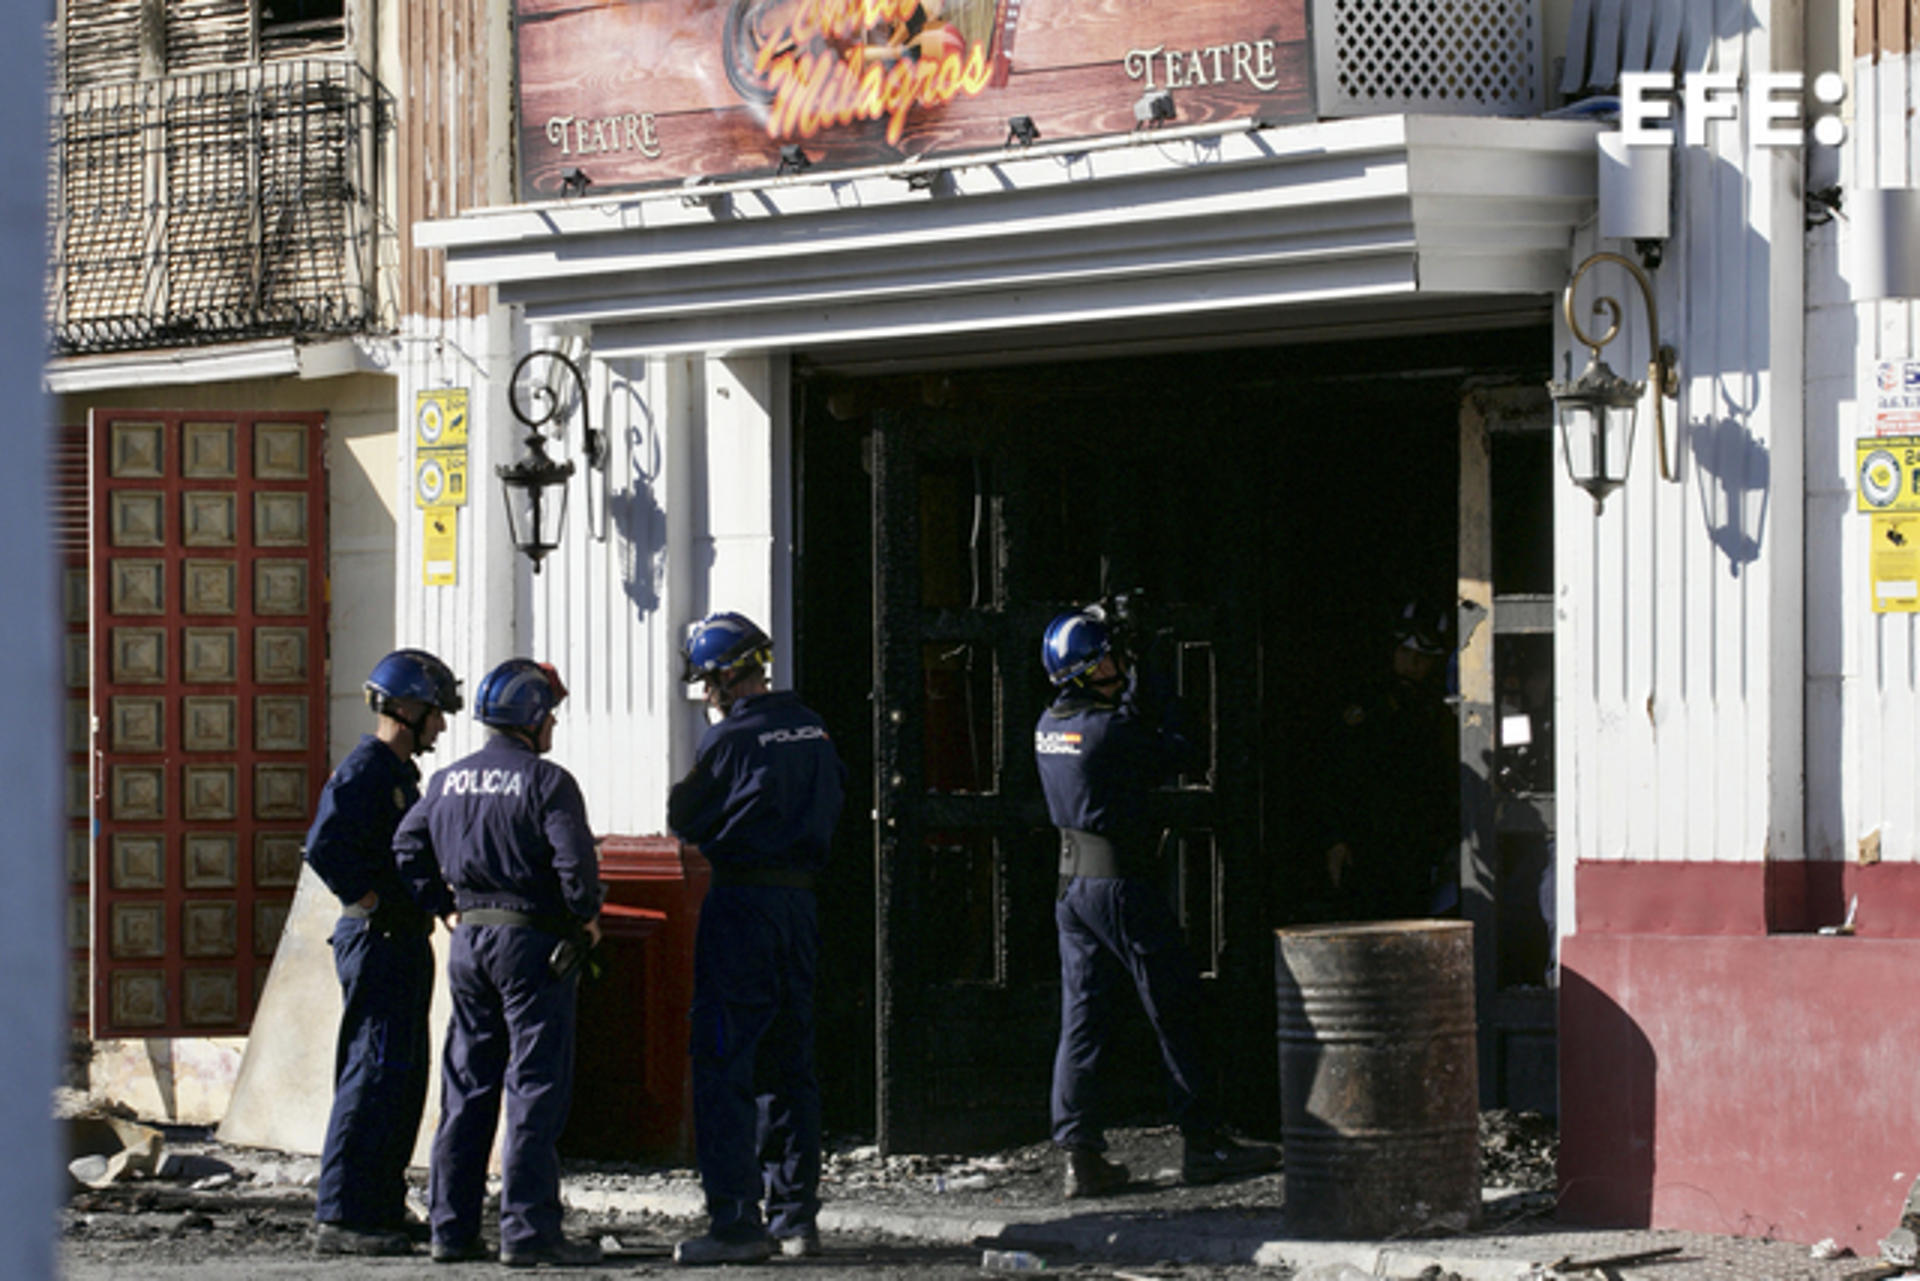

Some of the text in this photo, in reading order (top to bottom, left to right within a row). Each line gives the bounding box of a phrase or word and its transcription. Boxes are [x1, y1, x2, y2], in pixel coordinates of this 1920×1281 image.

[1125, 40, 1279, 91] TEATRE
[766, 41, 994, 146] Milagros
[546, 112, 661, 158] TEATRE
[442, 768, 521, 796] POLICIA
